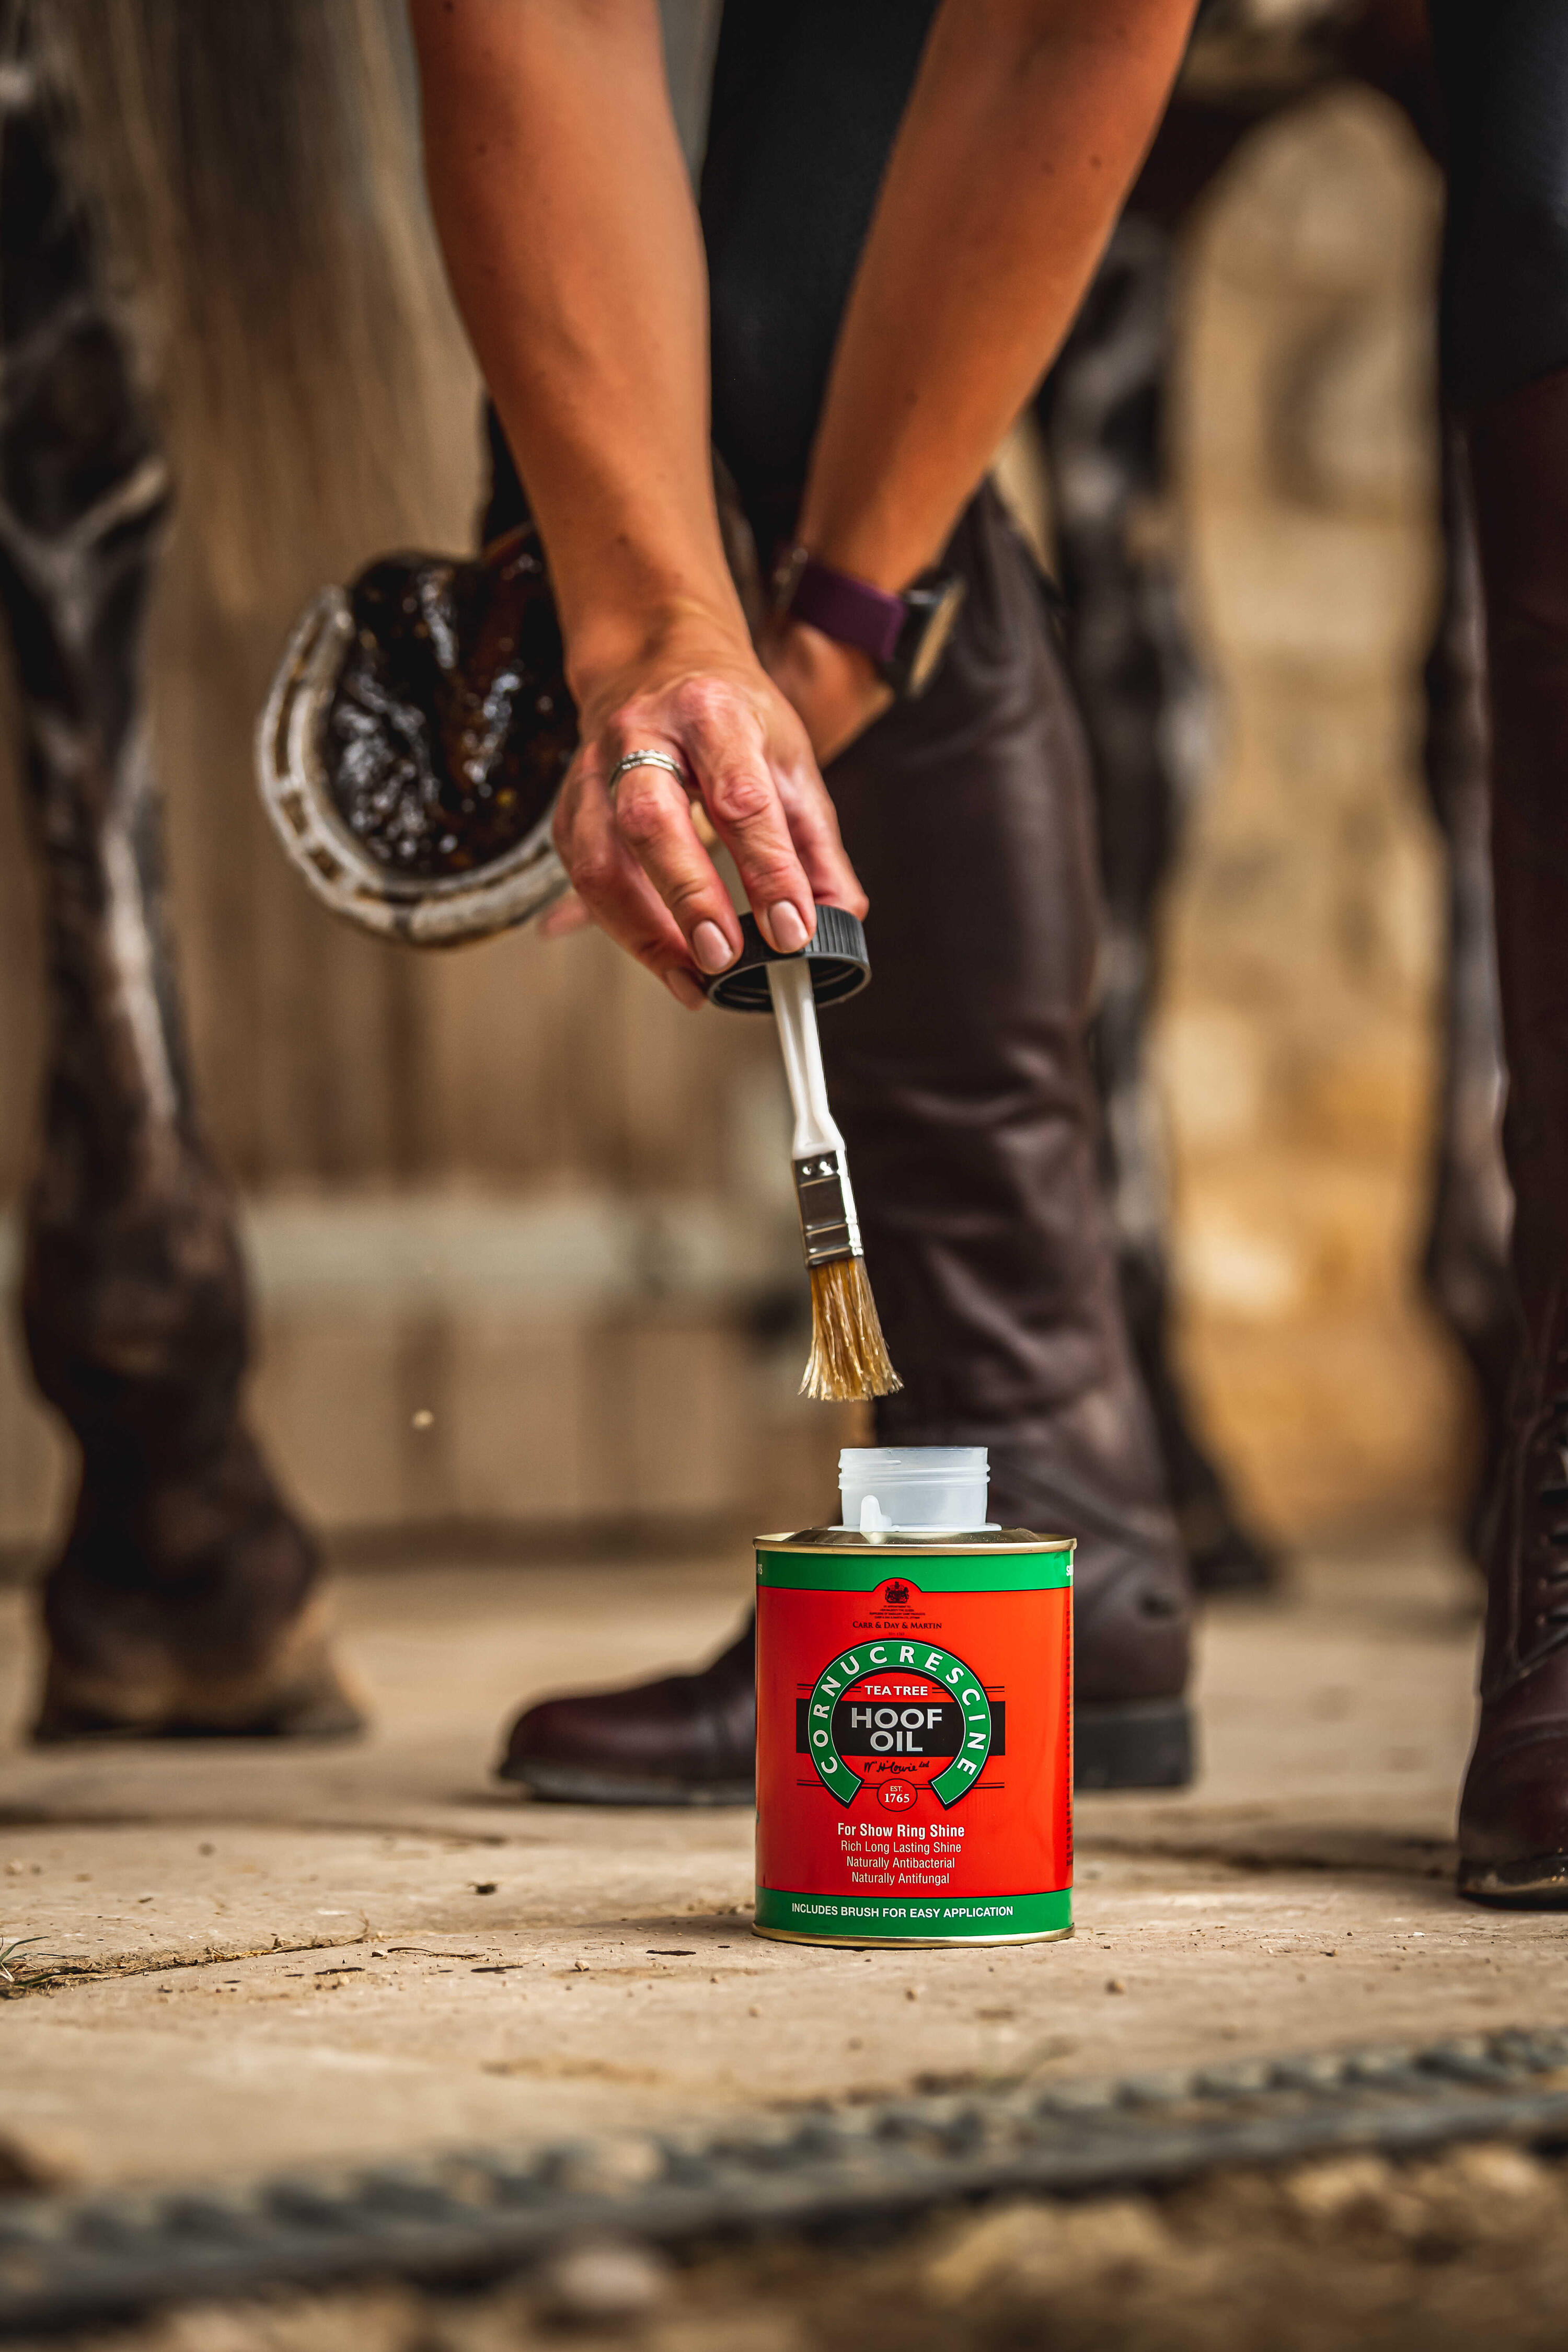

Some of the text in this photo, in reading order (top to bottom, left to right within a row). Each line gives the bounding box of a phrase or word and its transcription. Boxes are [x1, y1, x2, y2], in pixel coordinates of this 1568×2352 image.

[864, 1685, 928, 1696] TEA TREE
[813, 1645, 986, 1775] CORNUCRESCINE
[851, 1708, 942, 1729] HOOF
[870, 1731, 923, 1752] OIL
[884, 1793, 910, 1803] 1765
[838, 1823, 965, 1839] For Show Ring Shine
[841, 1840, 961, 1855] Rich Long Lasting Shine
[846, 1855, 955, 1870] Naturally Antibacterial
[852, 1871, 950, 1886] Naturally Antifungal
[792, 1903, 1013, 1918] INCLUDES BRUSH FOR EASY APPLICATION
